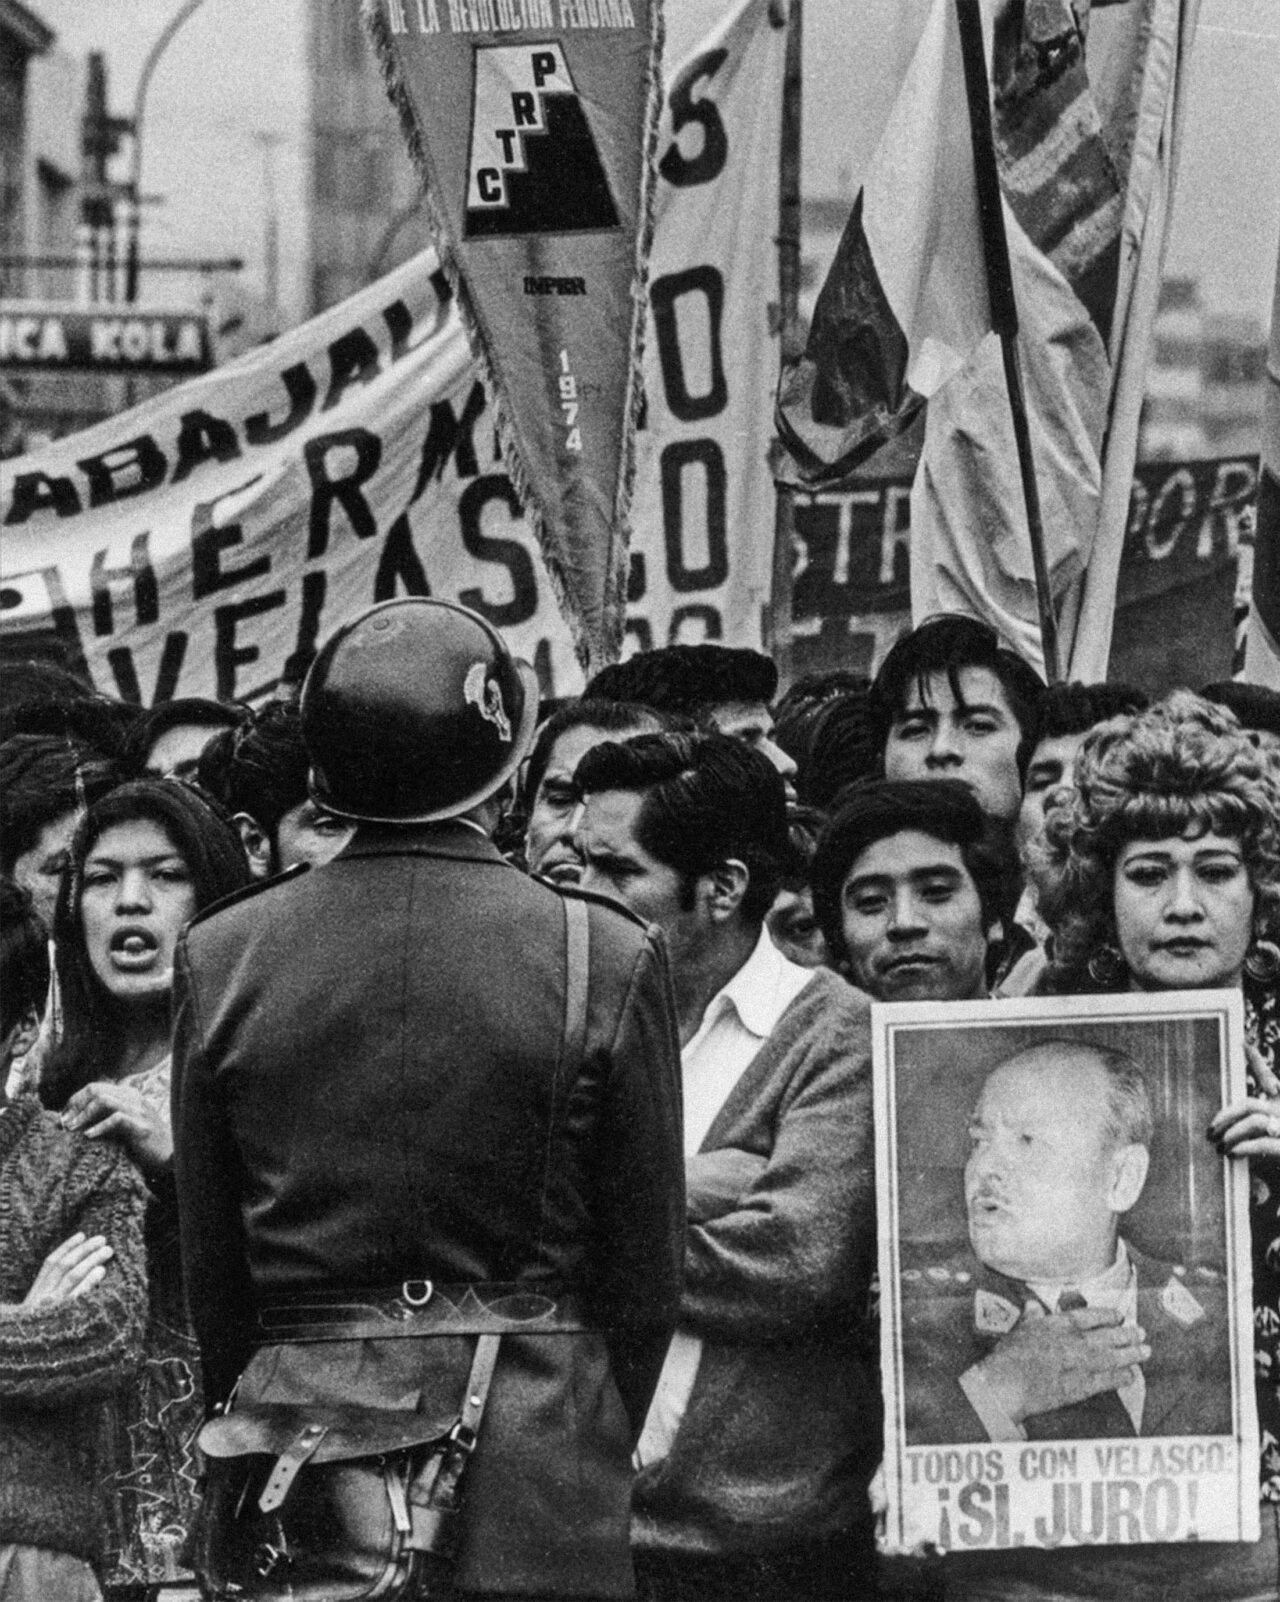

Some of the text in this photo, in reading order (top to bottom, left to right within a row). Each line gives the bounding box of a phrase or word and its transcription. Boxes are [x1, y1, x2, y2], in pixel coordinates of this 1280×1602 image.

[91, 319, 201, 361] KOLA
[559, 350, 582, 451] 1974
[906, 1440, 1234, 1484] TODOS CON VELASCO:
[1034, 1477, 1201, 1549] JURO!
